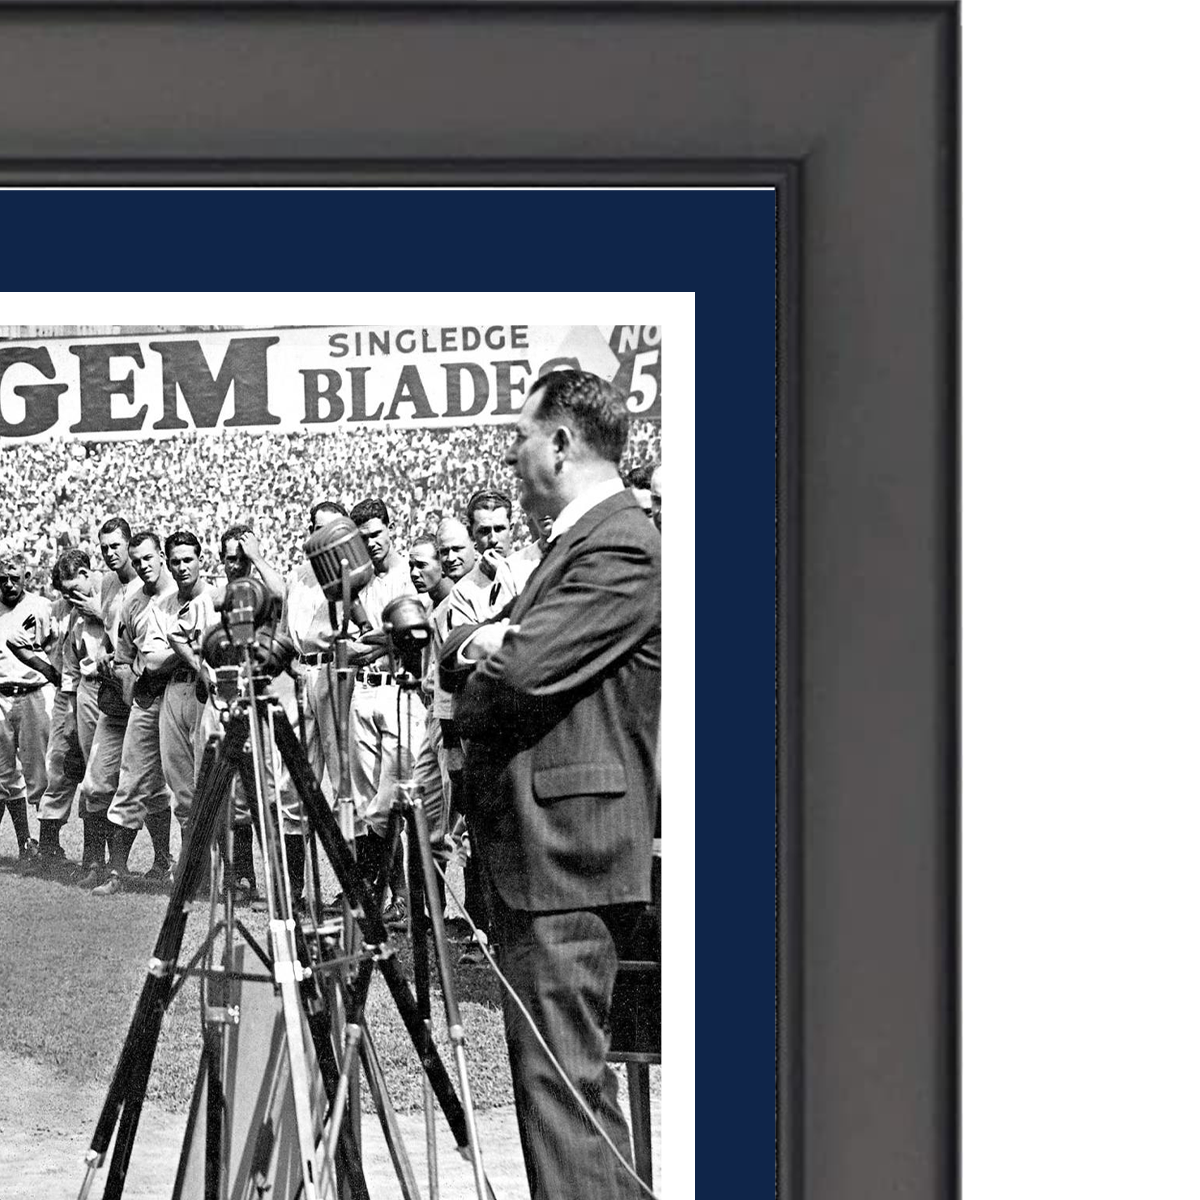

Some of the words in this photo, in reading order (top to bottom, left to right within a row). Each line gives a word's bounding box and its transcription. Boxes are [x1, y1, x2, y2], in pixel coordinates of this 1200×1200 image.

[328, 325, 529, 358] SINGLEDGE
[300, 357, 581, 425] BLADE
[626, 350, 659, 413] 5
